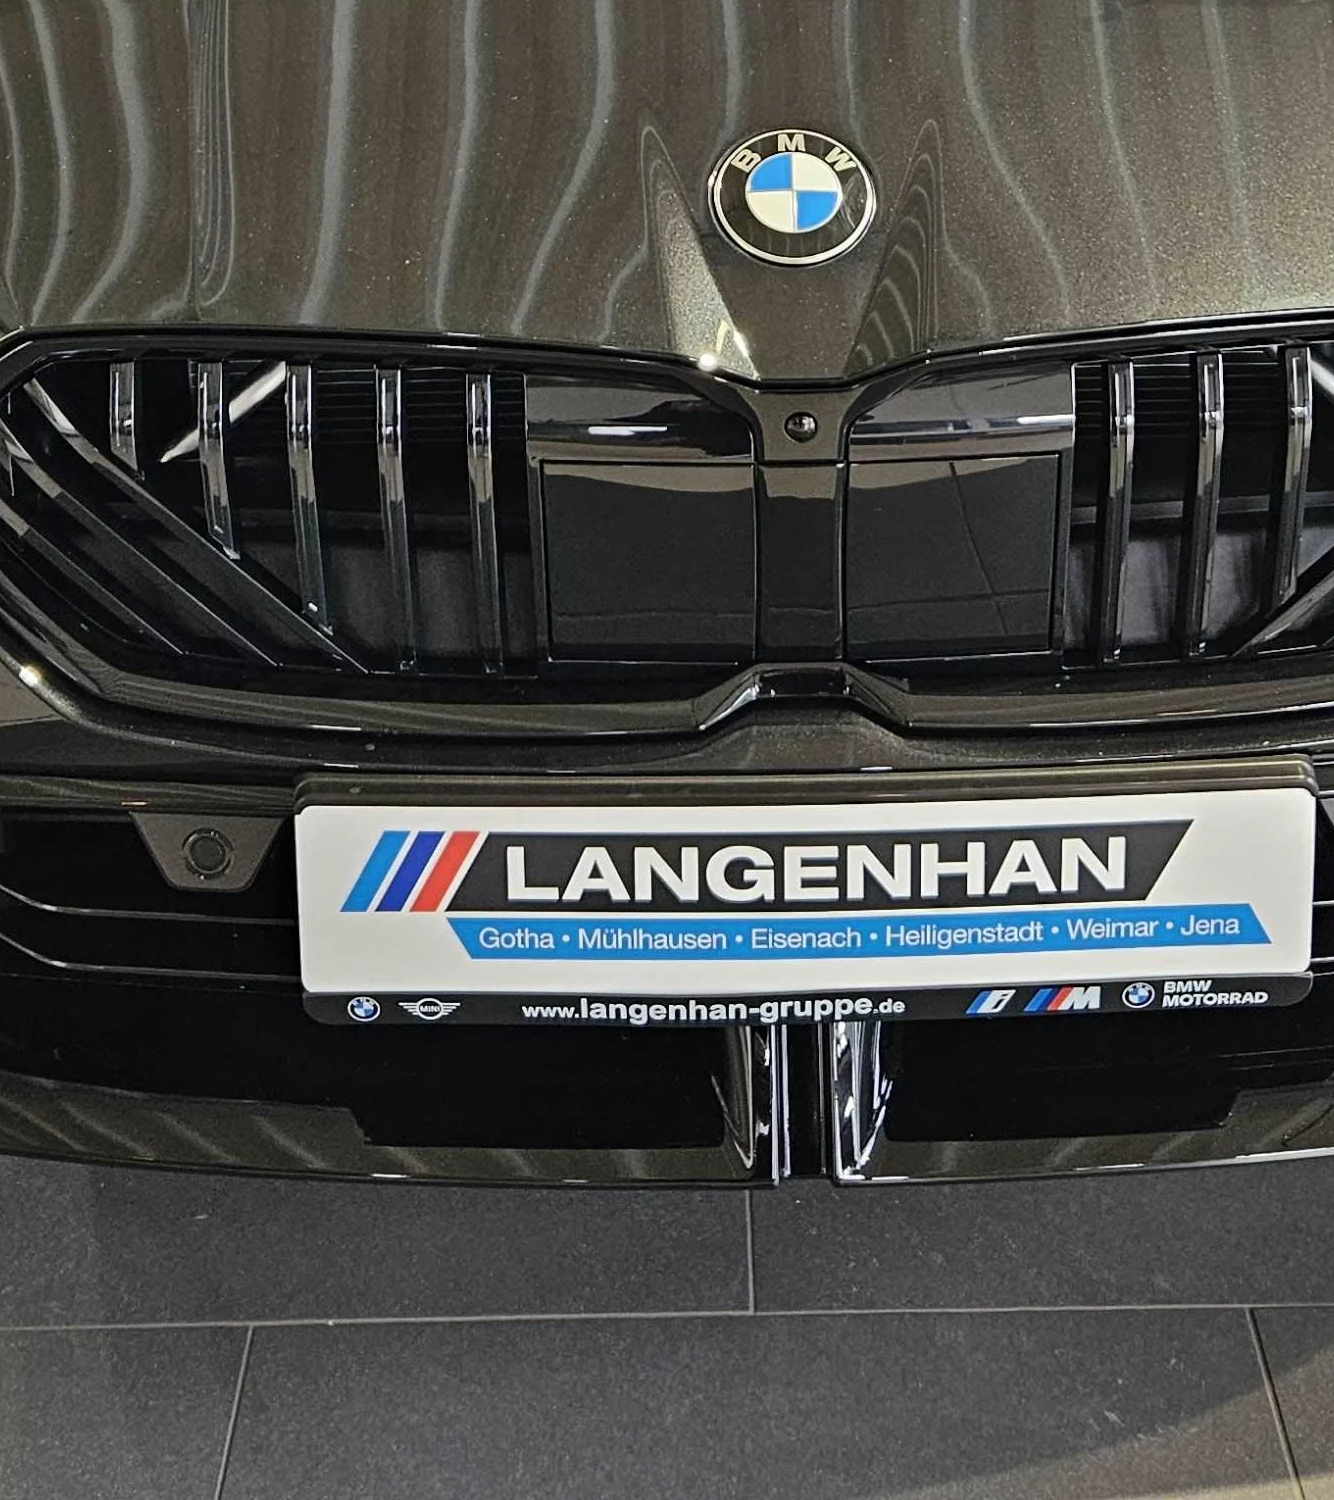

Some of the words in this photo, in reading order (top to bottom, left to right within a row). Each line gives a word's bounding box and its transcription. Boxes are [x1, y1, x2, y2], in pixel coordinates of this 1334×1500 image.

[731, 133, 857, 173] BMW
[505, 835, 1128, 904] LANGENHAN
[478, 926, 556, 950] Gotha
[578, 927, 727, 950] Mühlhausen
[751, 927, 862, 949] Eisenach
[886, 920, 1044, 950] Heiligenstadt
[1067, 917, 1159, 940] Weimar
[1180, 914, 1241, 937] Jena
[1161, 991, 1269, 1009] MOTORRAD
[1163, 979, 1213, 994] BMW
[419, 1005, 441, 1013] MINI
[521, 996, 907, 1026] www.langenhan-gruppe.de
